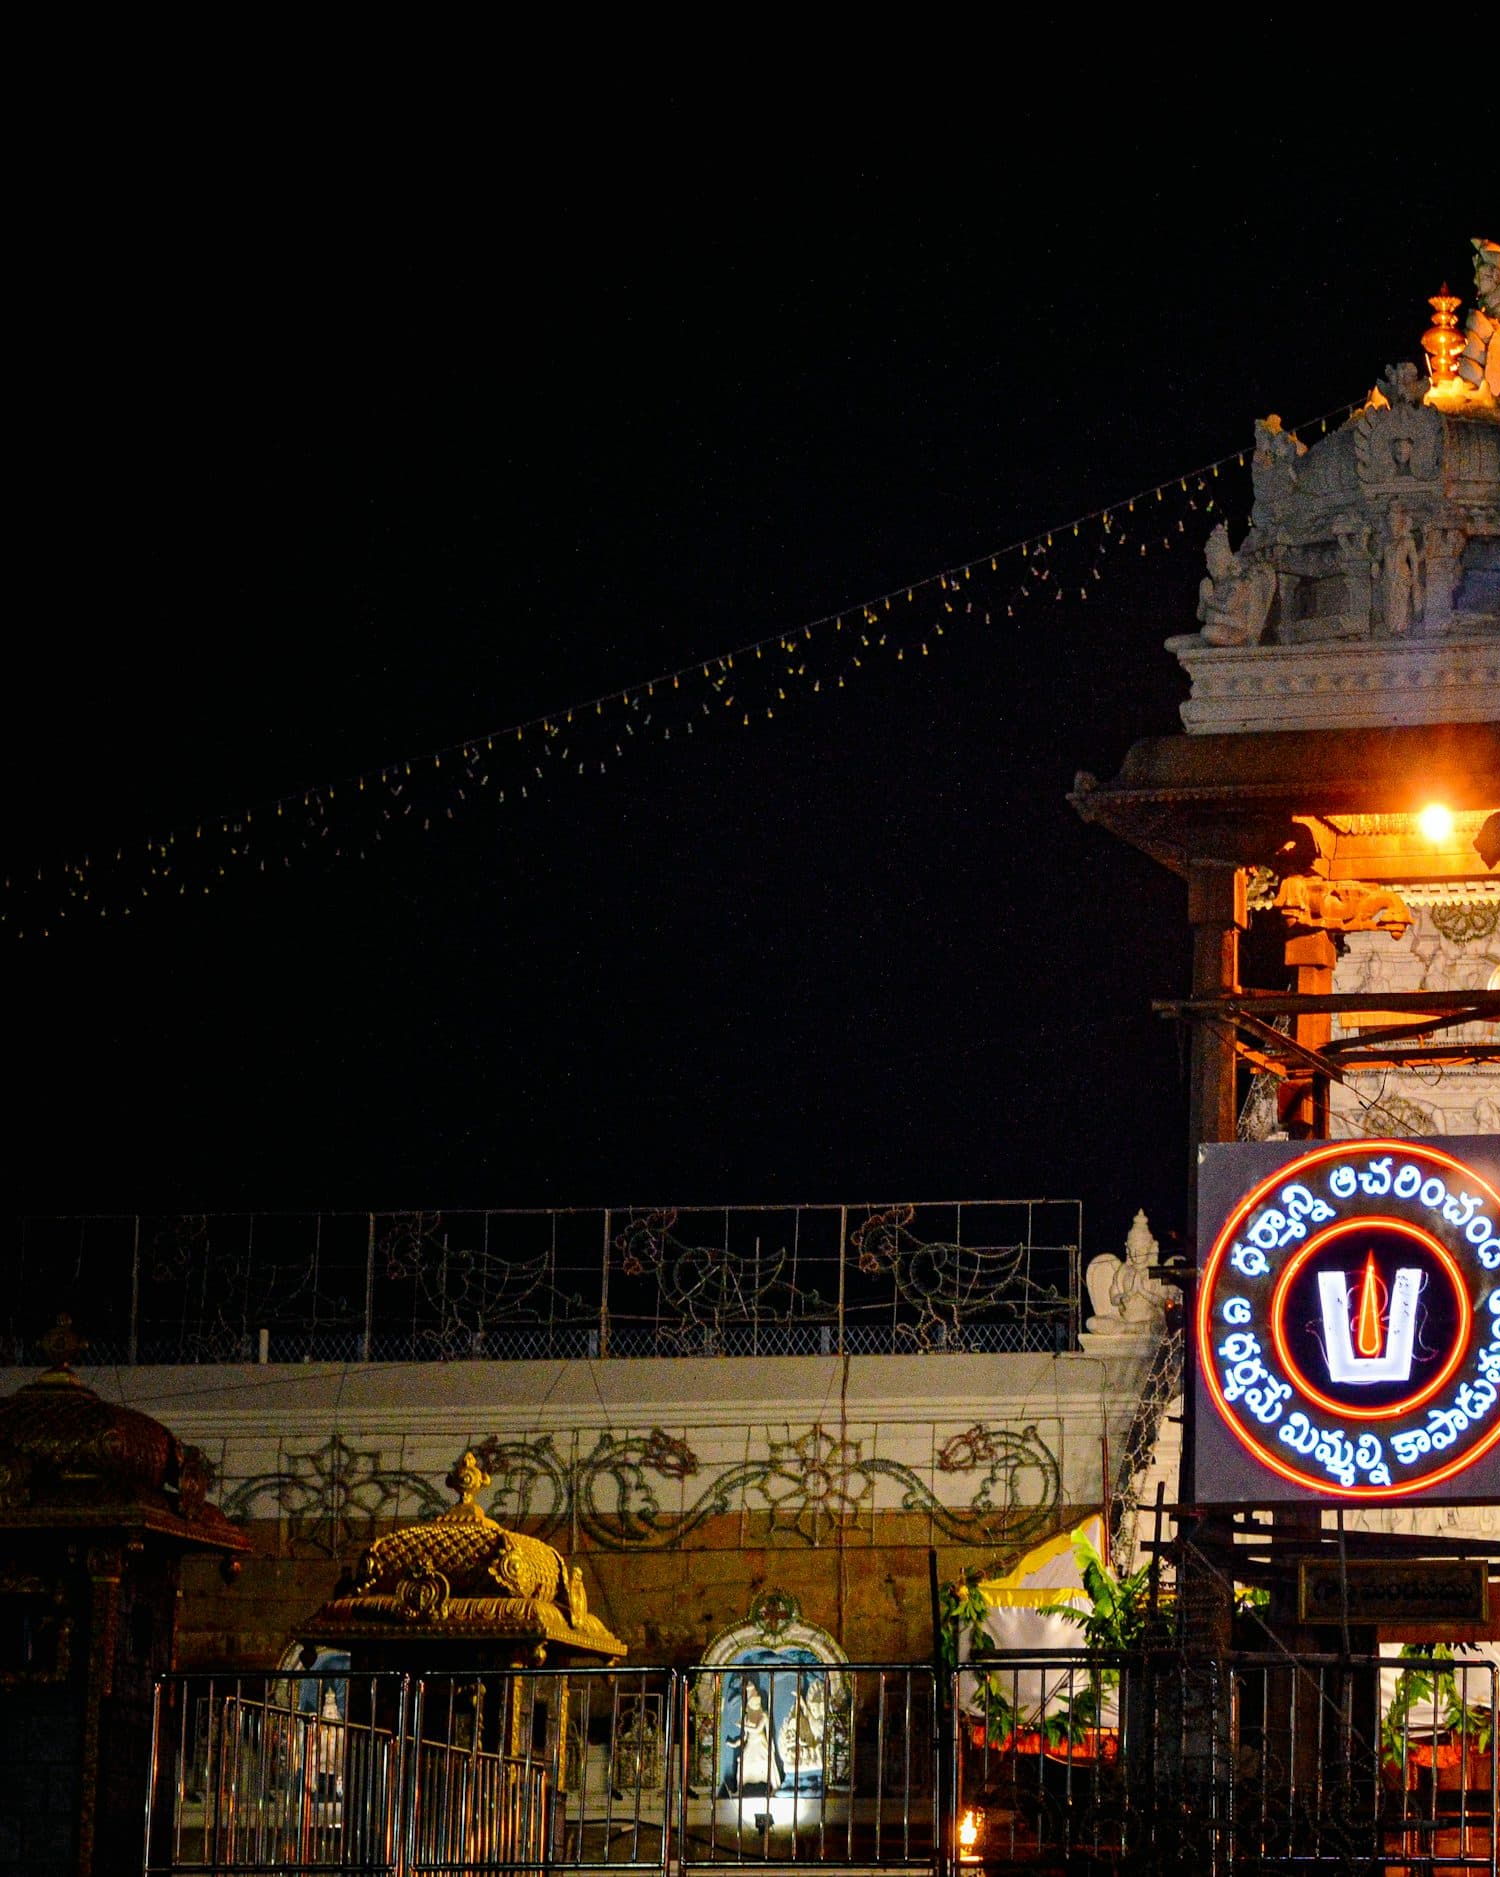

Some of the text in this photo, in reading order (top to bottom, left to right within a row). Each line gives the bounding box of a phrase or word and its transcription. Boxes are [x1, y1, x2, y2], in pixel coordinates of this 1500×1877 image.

[1229, 1183, 1337, 1278] ధర్మాన్ని
[1222, 1296, 1252, 1325] ఆ
[1217, 1331, 1294, 1425] ధర్మమే
[1277, 1411, 1393, 1488] మిమ్మల్ని
